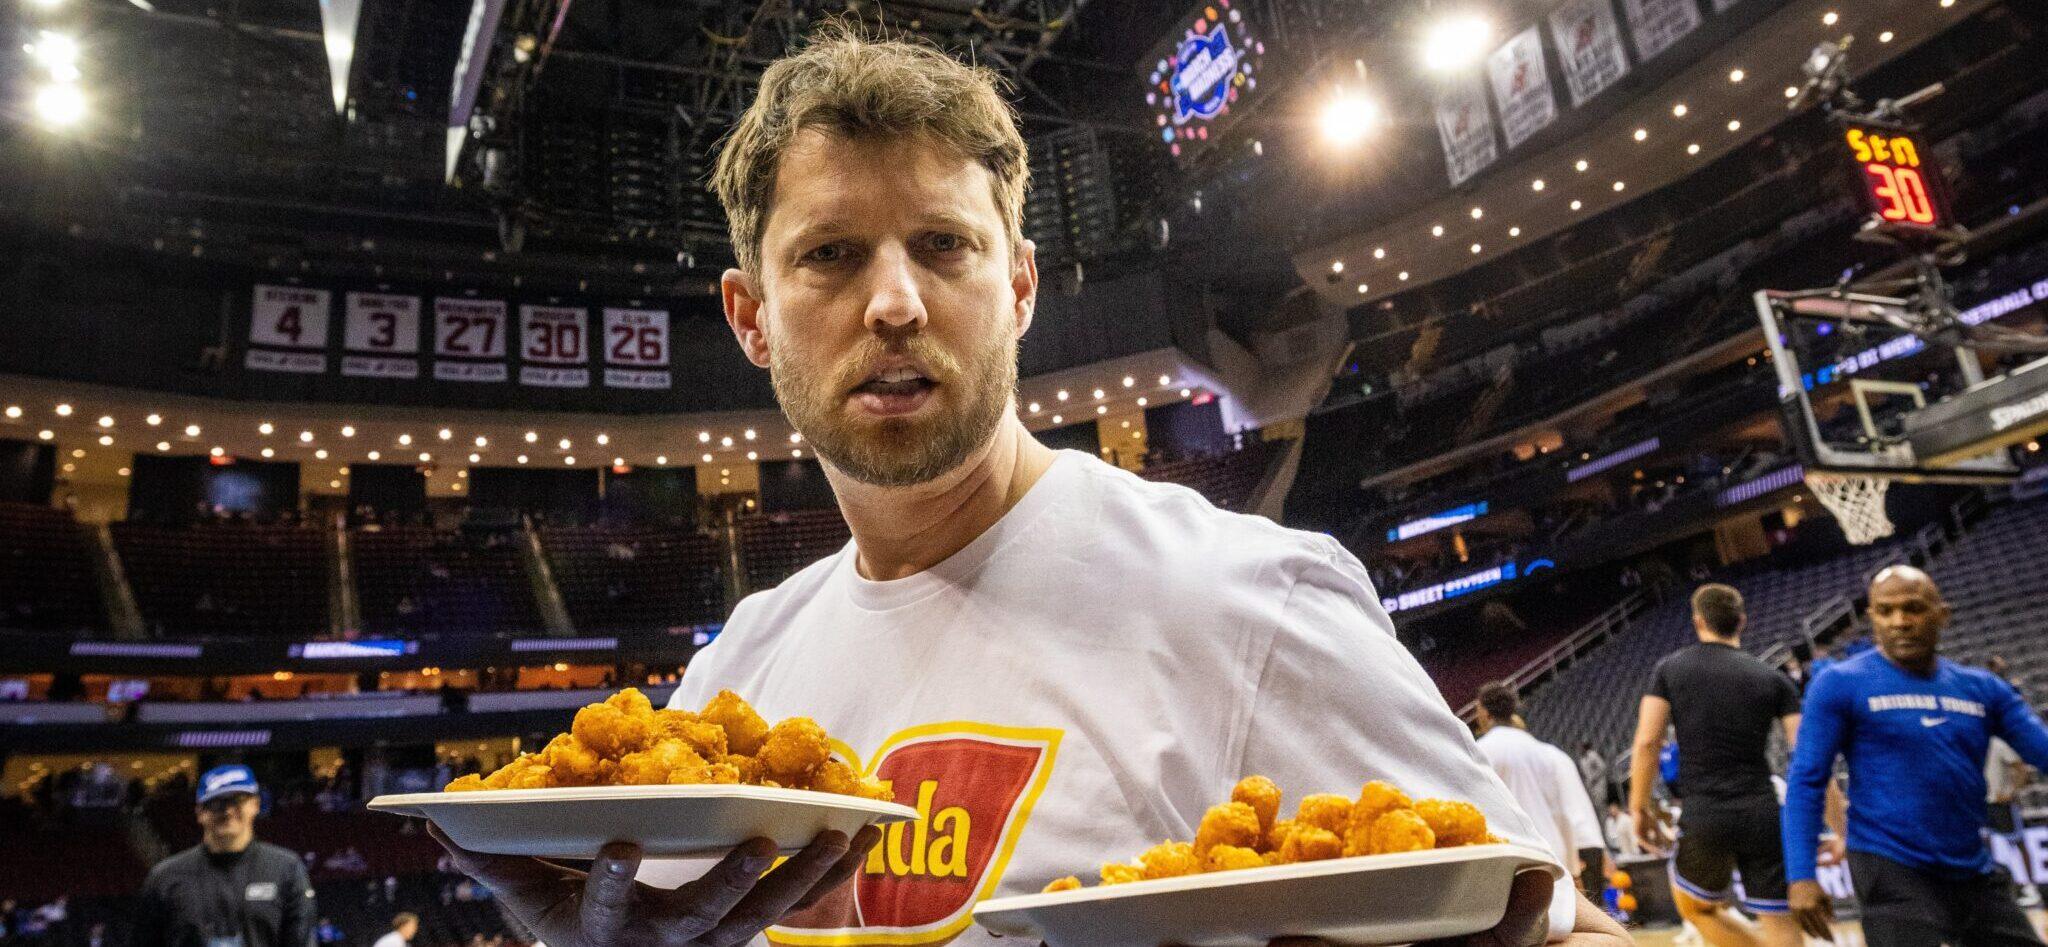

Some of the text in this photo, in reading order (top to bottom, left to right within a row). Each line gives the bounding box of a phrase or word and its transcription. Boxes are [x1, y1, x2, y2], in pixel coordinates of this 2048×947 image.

[1866, 163, 1935, 224] 30
[275, 306, 303, 344] 4
[368, 313, 397, 348] 3
[444, 316, 497, 354] 27
[528, 322, 581, 360] 30
[611, 326, 661, 361] 26
